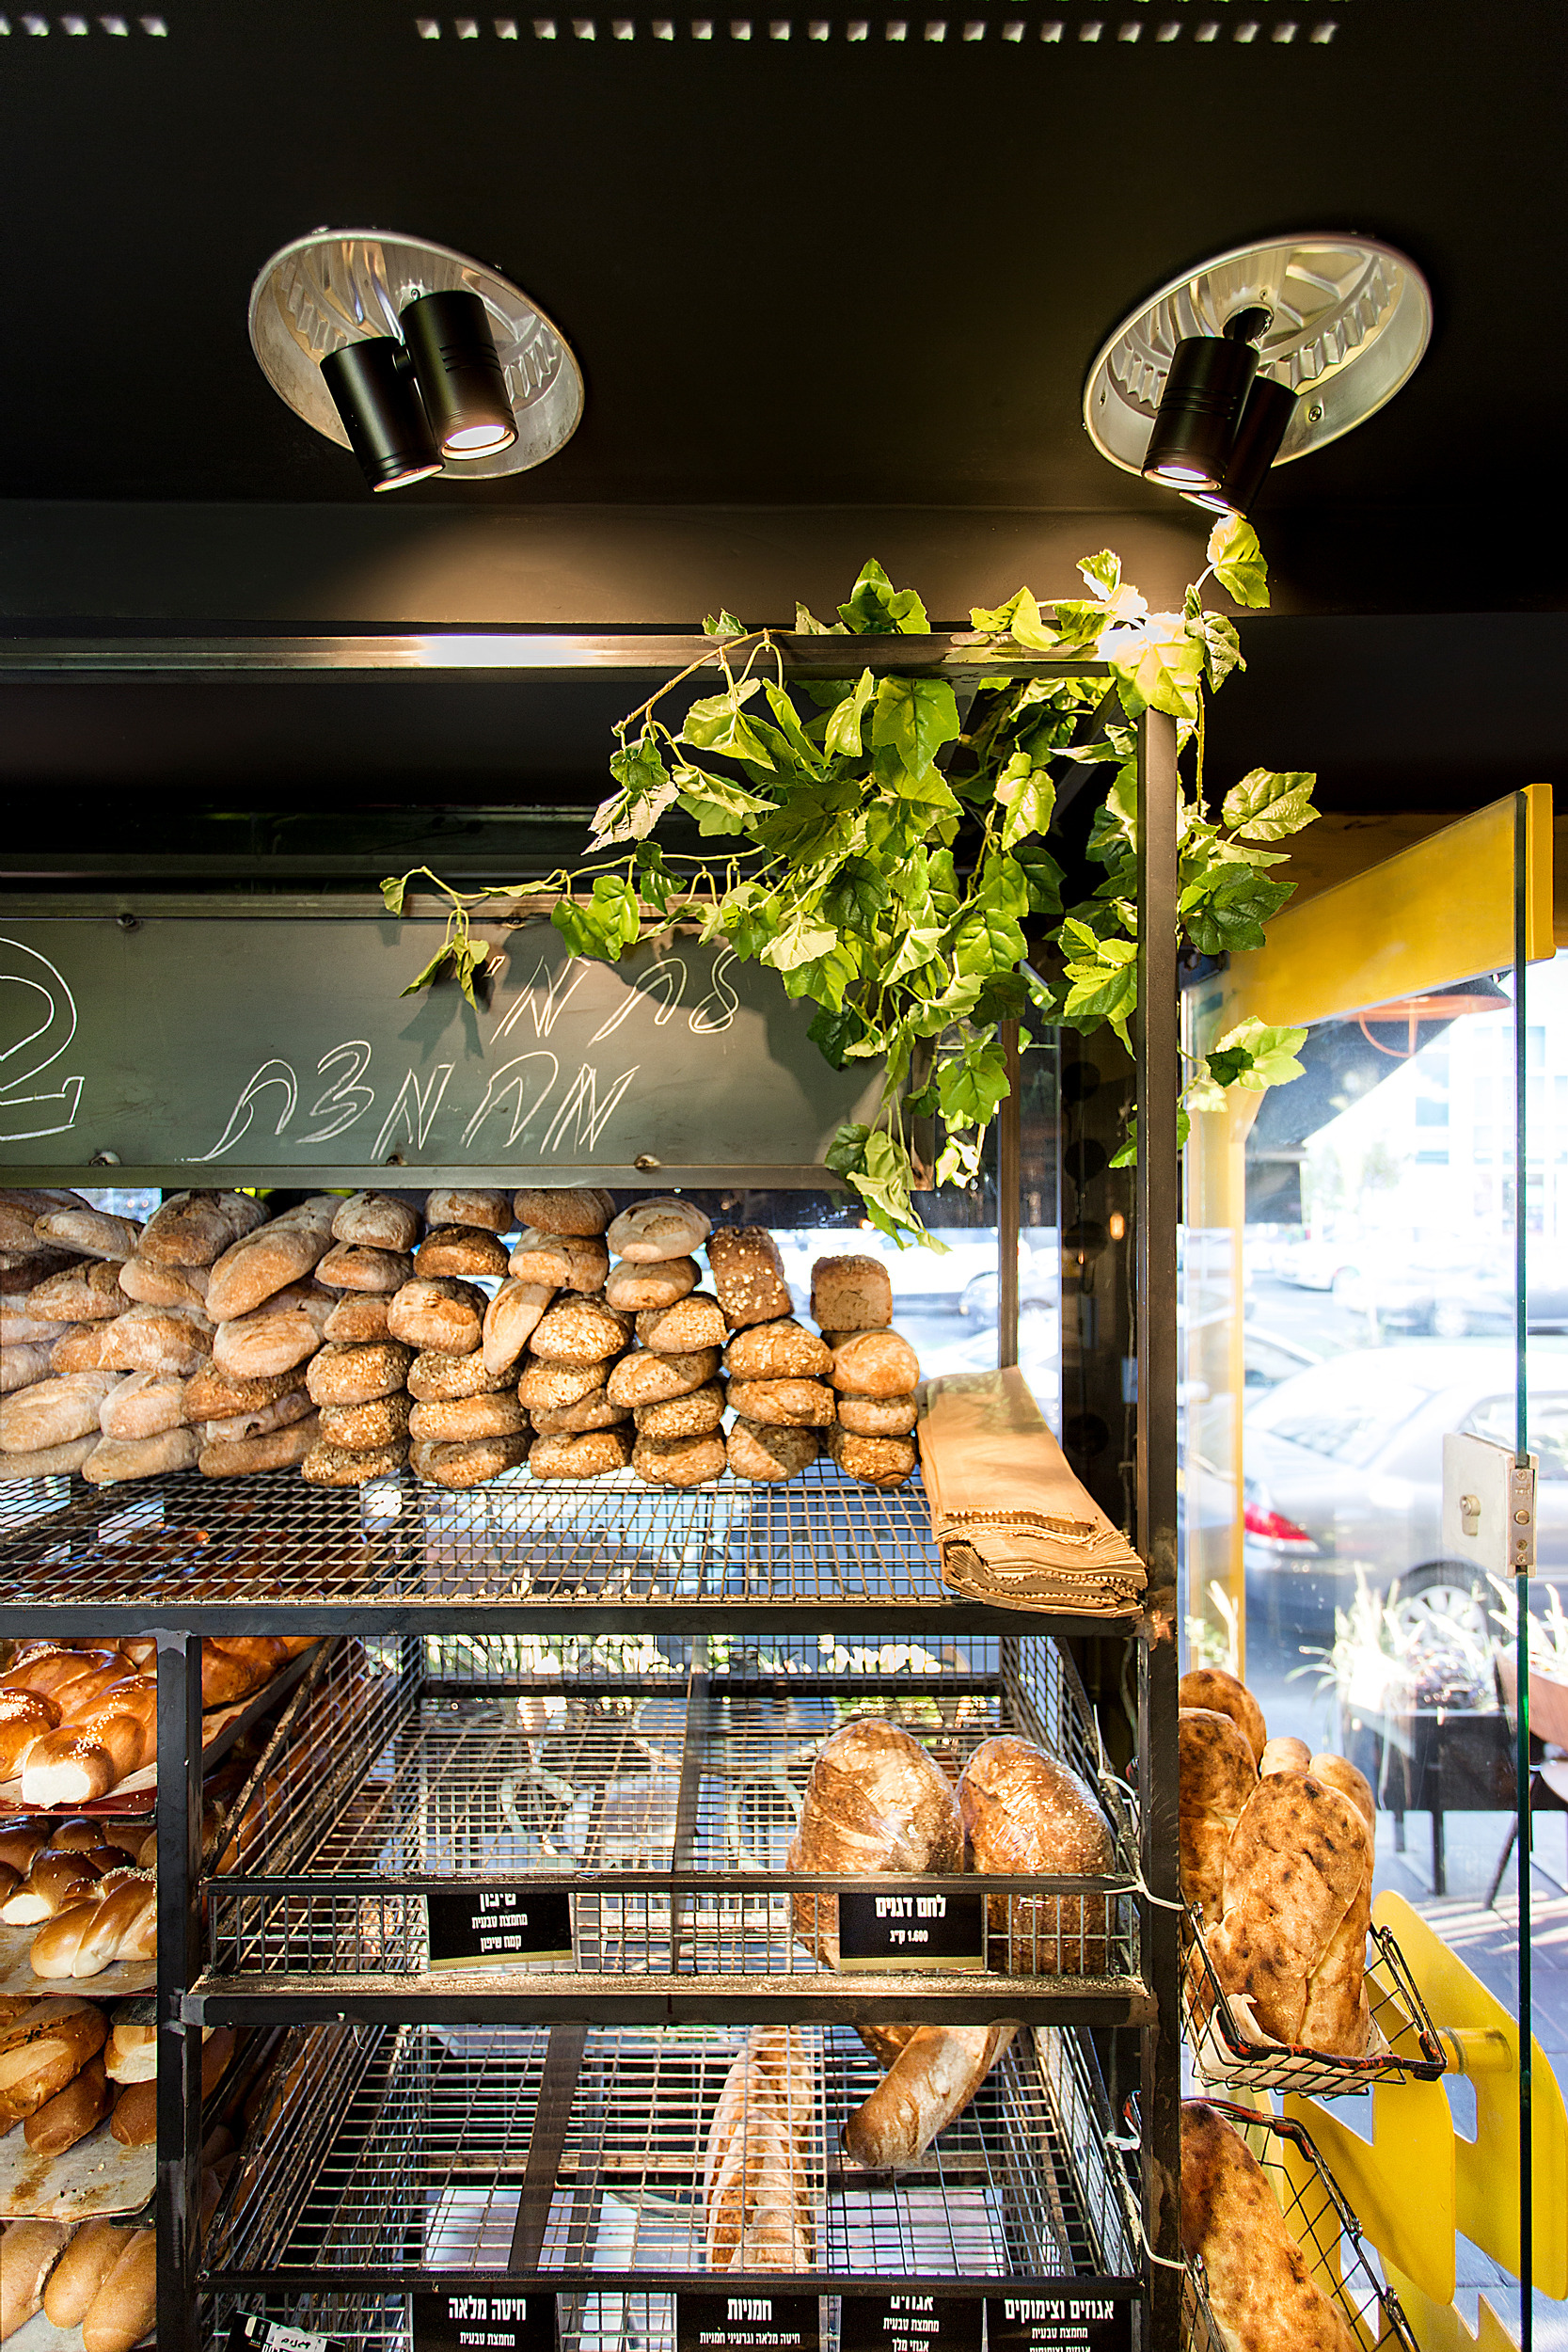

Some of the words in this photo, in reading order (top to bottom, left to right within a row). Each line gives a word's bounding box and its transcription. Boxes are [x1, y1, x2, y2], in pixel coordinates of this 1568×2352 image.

[875, 1897, 913, 1917] דגנים
[916, 1894, 946, 1917] לחם
[471, 1915, 499, 1930] טבעית
[499, 1914, 529, 1928] מחמצת
[480, 1936, 502, 1953] שיפון
[503, 1935, 522, 1950] קמח
[449, 2295, 487, 2320] מלאה
[491, 2298, 527, 2321] חיטה
[727, 2298, 772, 2321] חמניות
[1004, 2298, 1066, 2324] וצימוקים
[1069, 2299, 1115, 2320] אגוזים
[882, 2316, 910, 2330] טבעית
[911, 2318, 940, 2332] מחמצת
[459, 2331, 485, 2345] טבעית
[486, 2333, 515, 2347] מחמצת
[699, 2331, 726, 2344] חמניות
[727, 2332, 754, 2345] וגרעיני
[755, 2331, 779, 2345] מלאה
[780, 2332, 800, 2345] חיטה
[1031, 2327, 1058, 2340] טבעית
[1059, 2327, 1089, 2340] מחמצת
